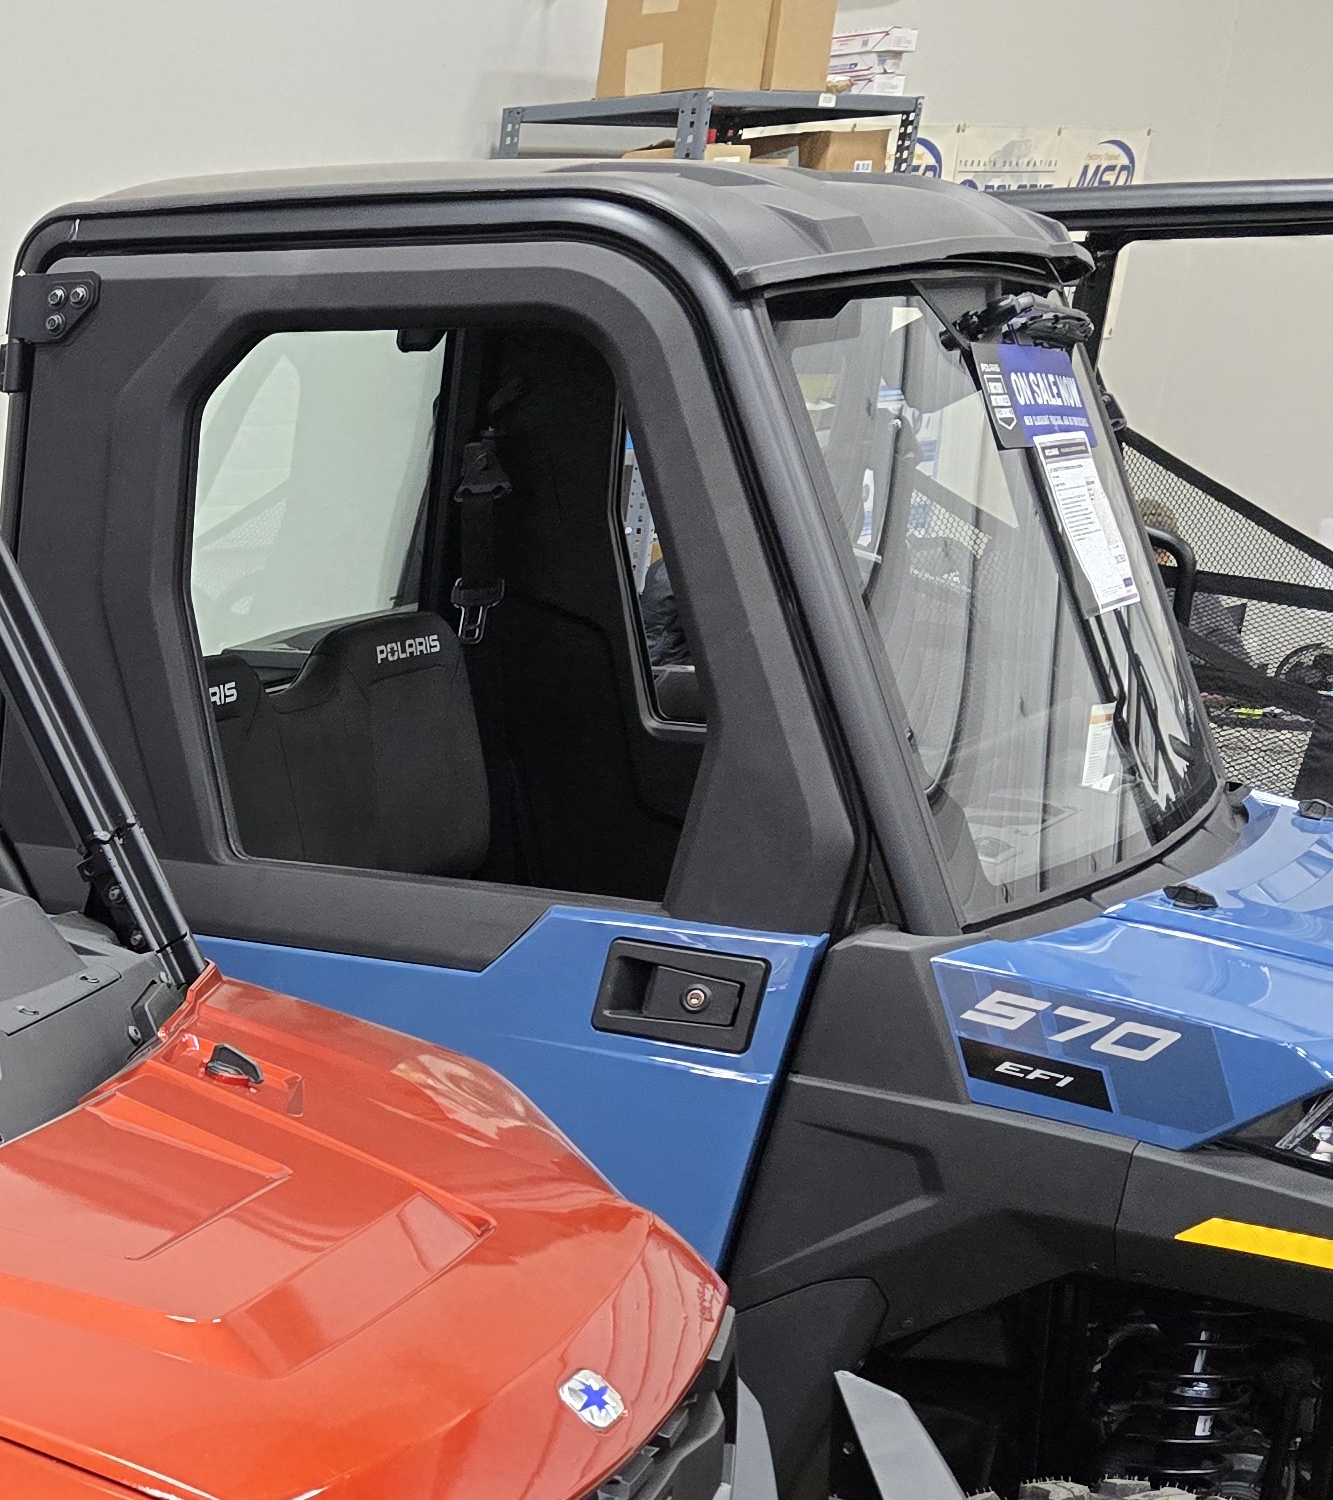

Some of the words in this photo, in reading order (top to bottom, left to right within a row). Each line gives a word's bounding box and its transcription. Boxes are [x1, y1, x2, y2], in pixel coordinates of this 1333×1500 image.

[1011, 372, 1034, 405] ON
[1029, 372, 1063, 405] SALE
[1055, 375, 1082, 408] NOW
[376, 635, 440, 664] POLARIS
[960, 990, 1182, 1062] 570
[994, 1061, 1075, 1088] EFI
